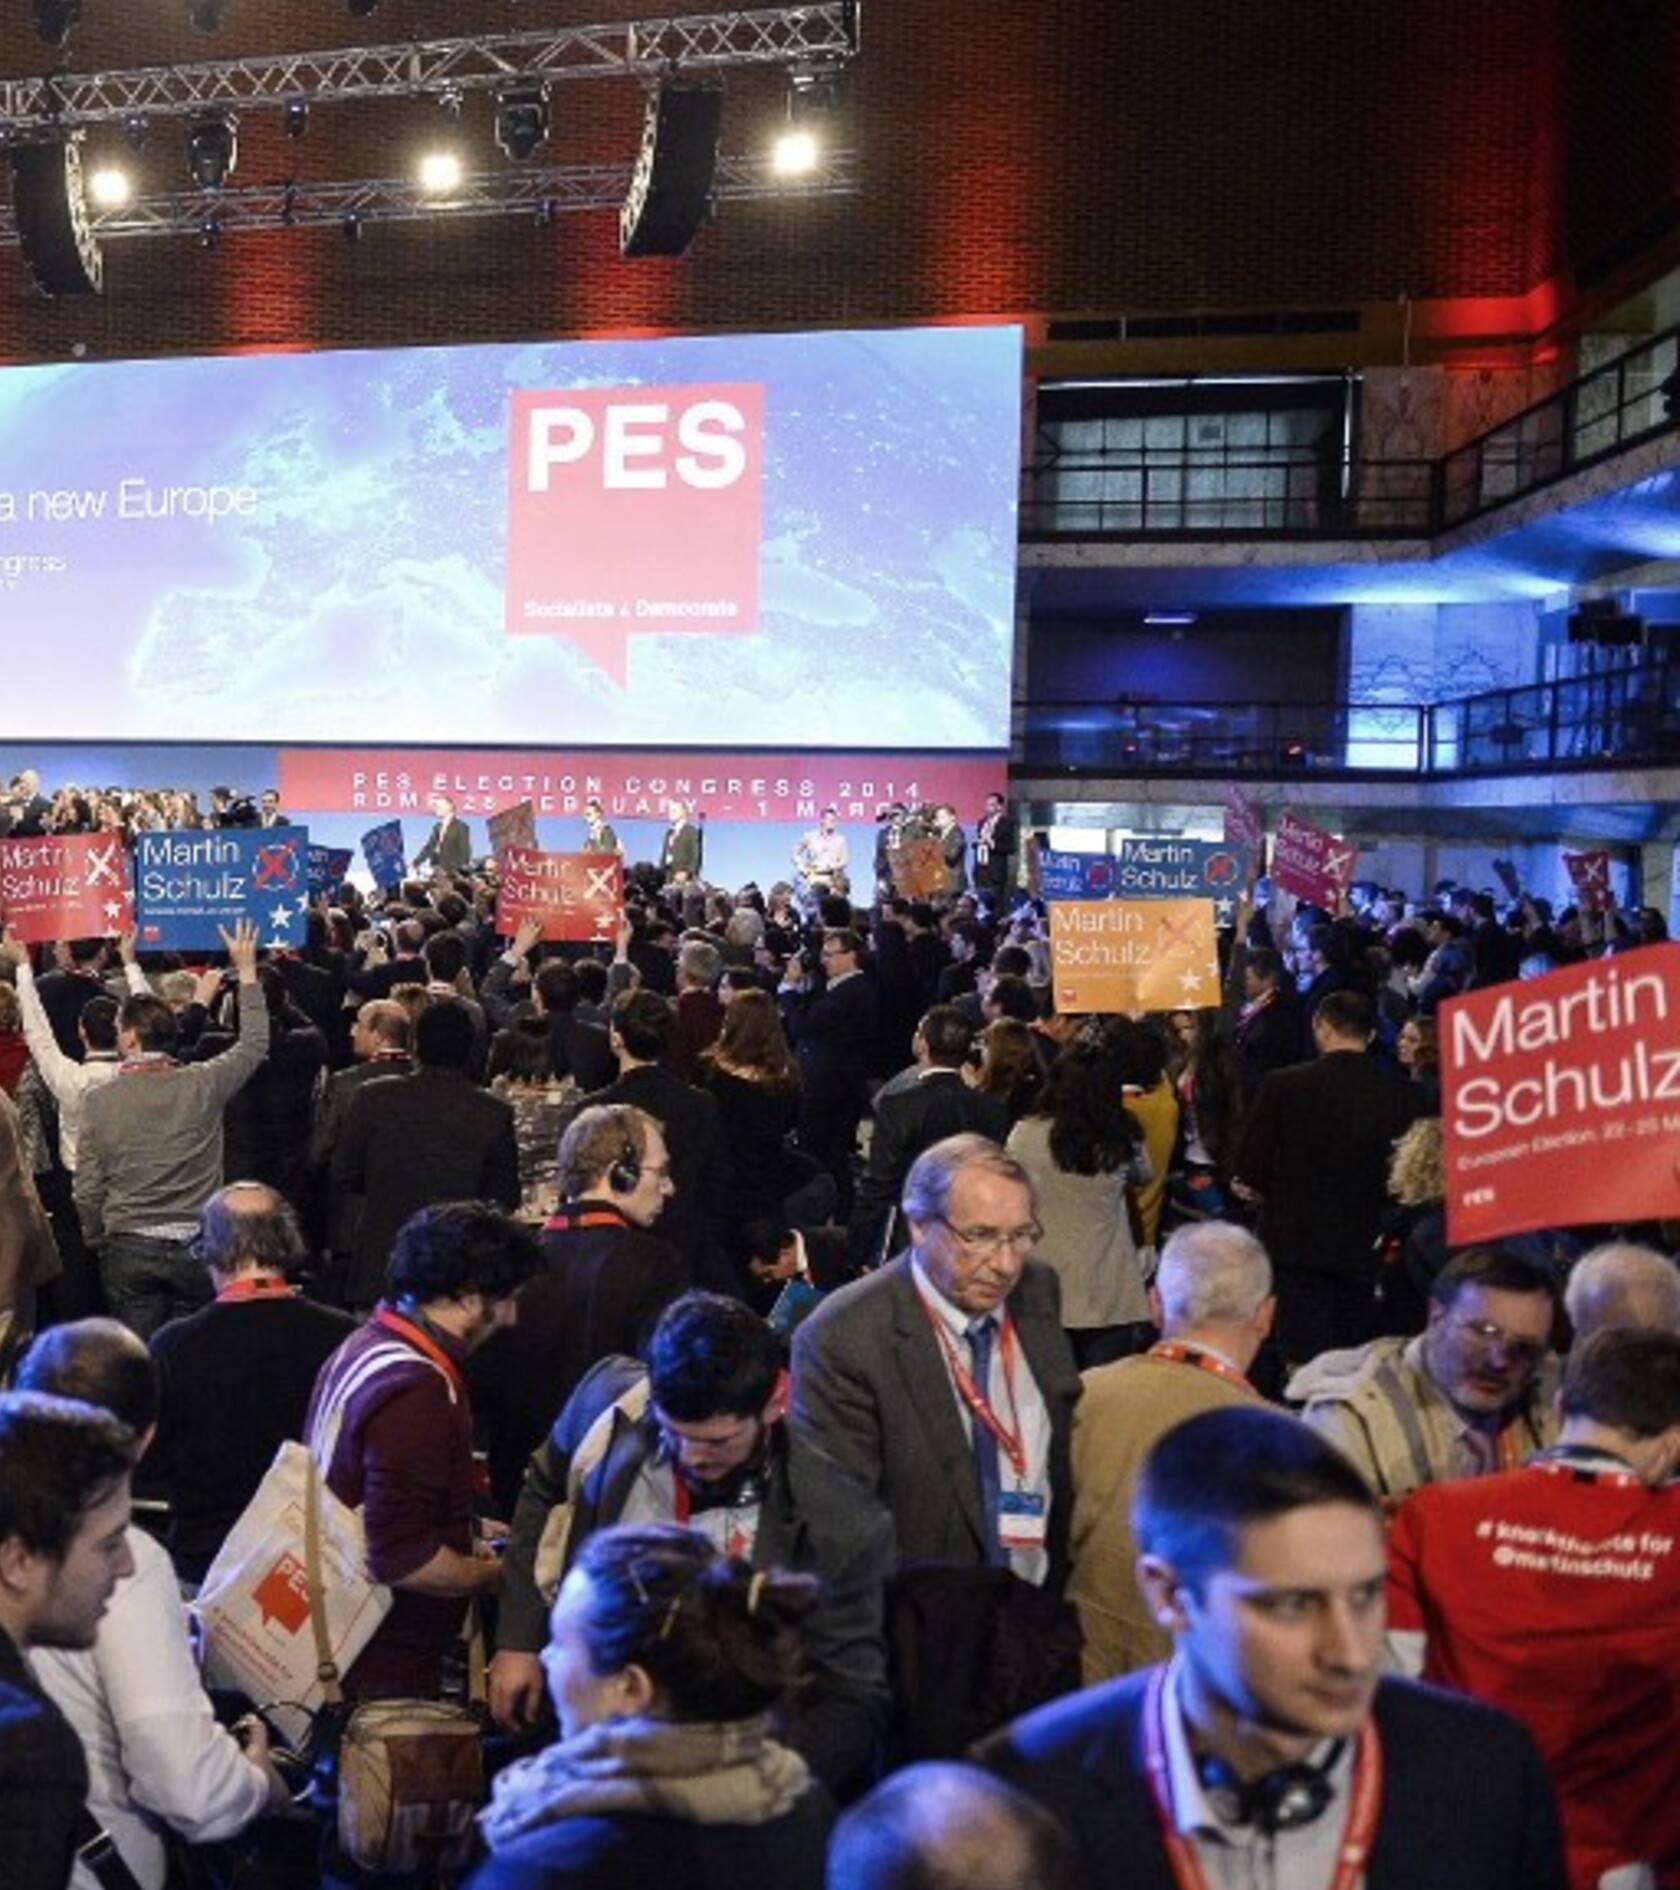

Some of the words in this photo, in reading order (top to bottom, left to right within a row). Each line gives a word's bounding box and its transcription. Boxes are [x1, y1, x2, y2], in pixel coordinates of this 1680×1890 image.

[528, 401, 746, 492] PES
[27, 489, 107, 521] new
[119, 478, 259, 524] Europe
[524, 601, 614, 617] Socialists
[636, 599, 737, 616] Democrats
[353, 772, 411, 790] PES
[432, 774, 603, 793] ELECTION
[625, 778, 816, 798] CONGRESS
[839, 781, 919, 798] 2014
[143, 837, 240, 866] Martin
[1124, 842, 1193, 864] Martin
[2, 874, 80, 900] Schulz
[143, 872, 246, 900] Schulz
[1121, 865, 1198, 889] Schulz
[1054, 907, 1144, 932] Martin
[1055, 939, 1151, 965] Schulz
[1452, 968, 1667, 1069] Martin
[1454, 1040, 1680, 1138] Schulz
[1640, 1534, 1674, 1555] for
[275, 1556, 310, 1604] PE
